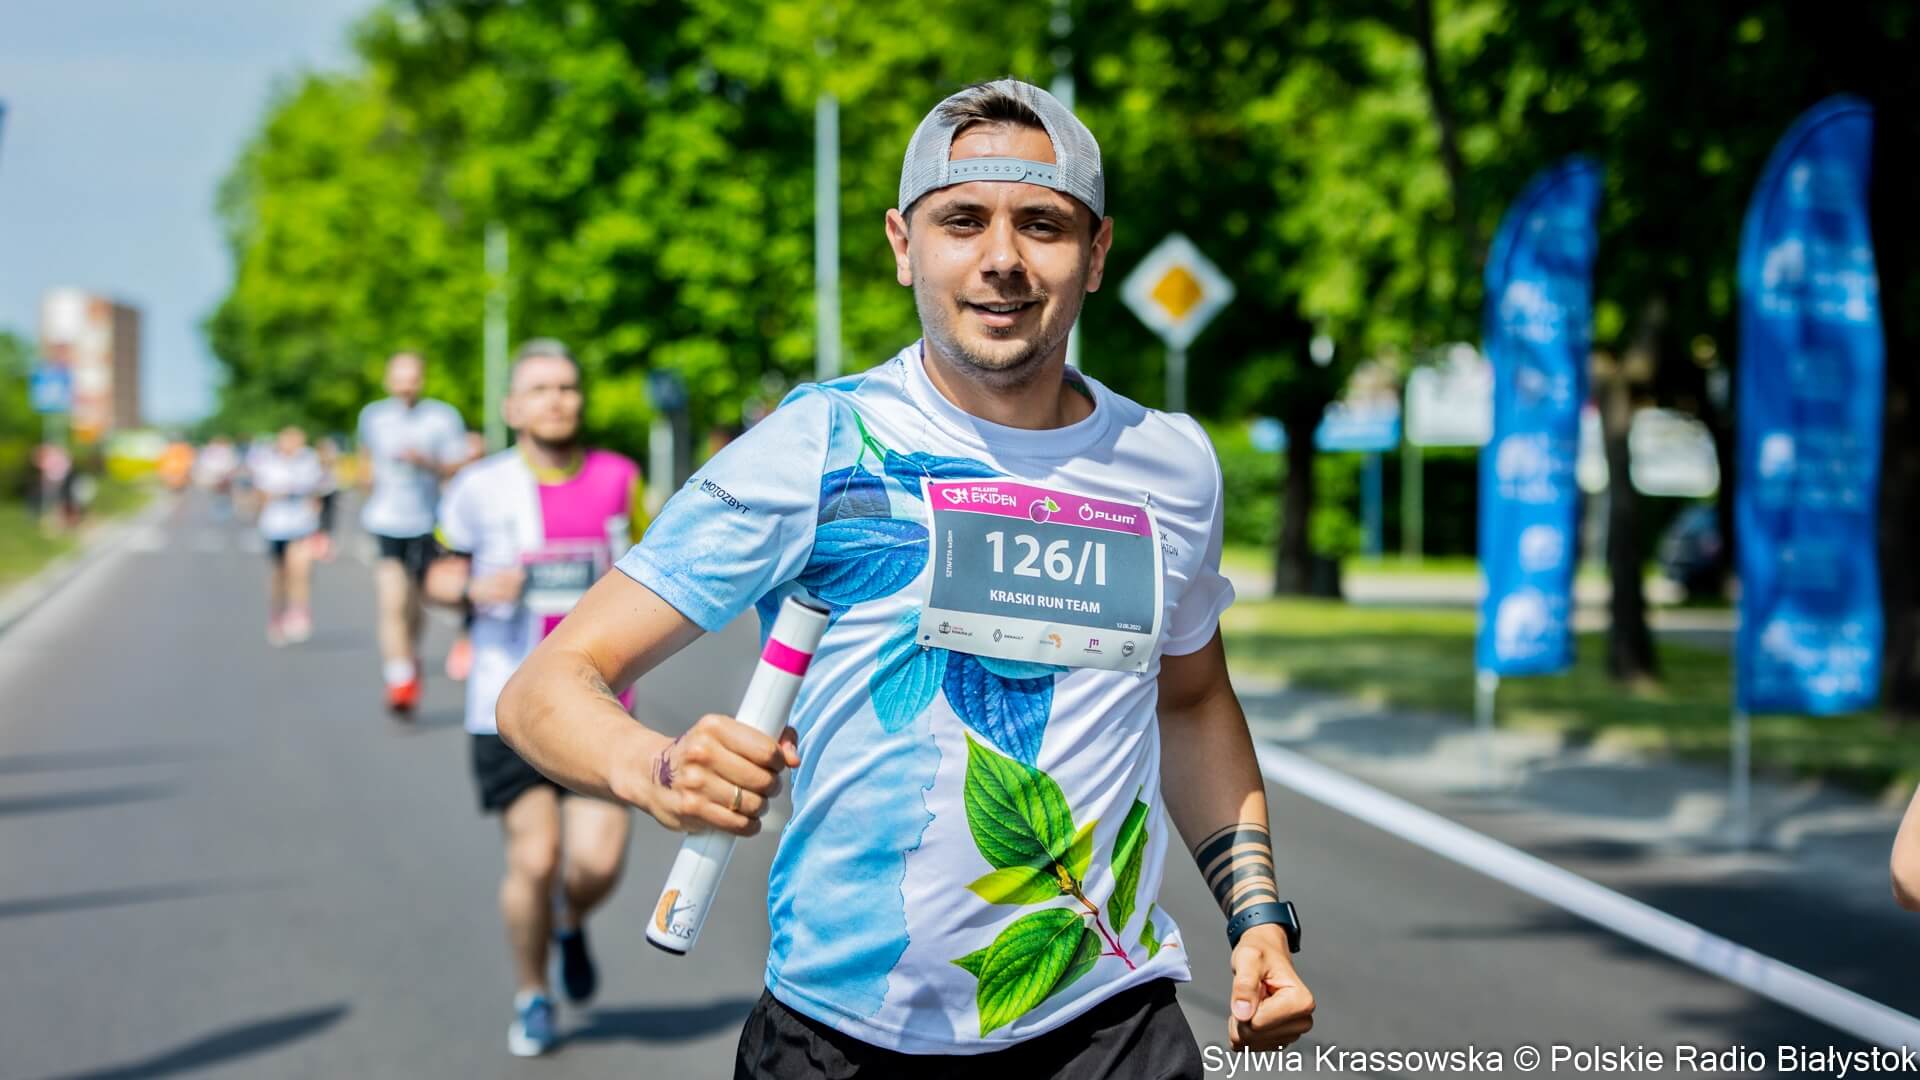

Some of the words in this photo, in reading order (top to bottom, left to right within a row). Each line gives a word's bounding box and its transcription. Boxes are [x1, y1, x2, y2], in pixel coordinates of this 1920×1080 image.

[702, 479, 750, 514] MOTOZBYT
[971, 492, 1017, 507] EKIDEN
[1095, 511, 1137, 525] PLUM
[990, 589, 1035, 606] KRASKI
[1037, 595, 1063, 609] RUN
[1065, 598, 1101, 614] TEAM
